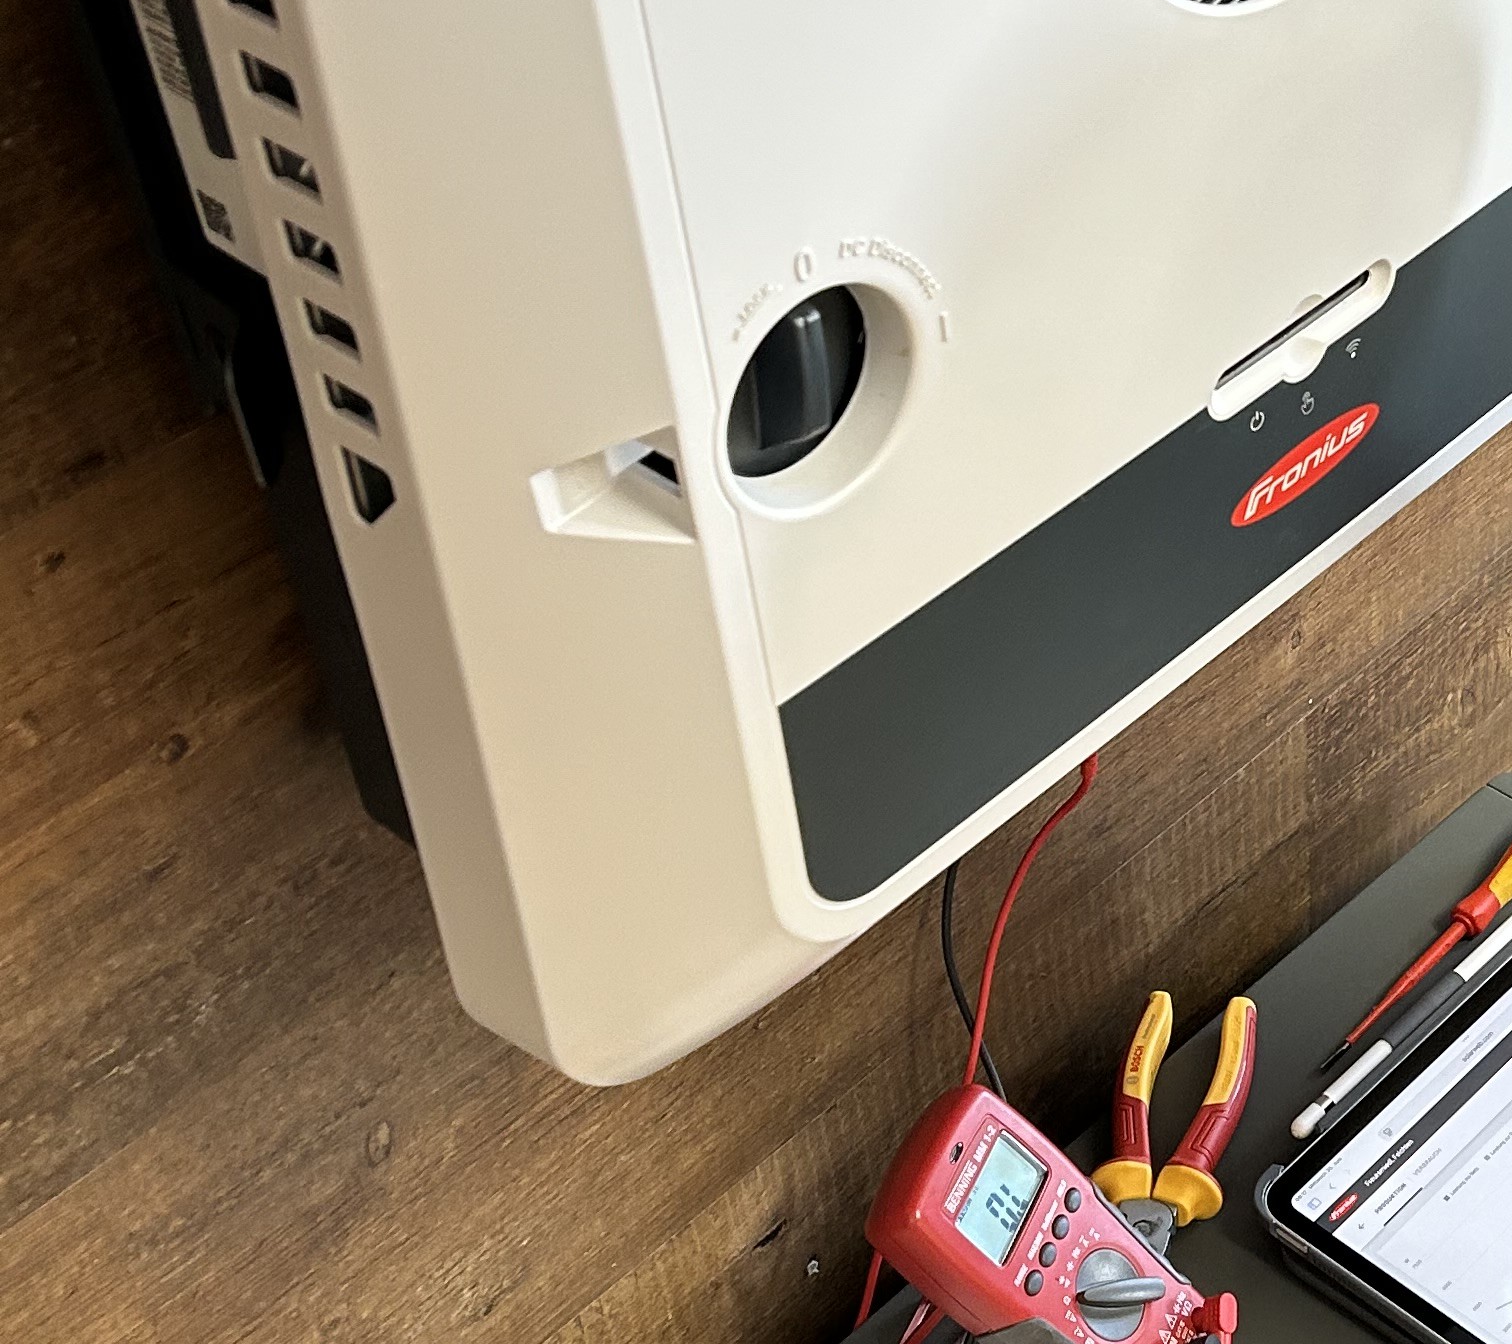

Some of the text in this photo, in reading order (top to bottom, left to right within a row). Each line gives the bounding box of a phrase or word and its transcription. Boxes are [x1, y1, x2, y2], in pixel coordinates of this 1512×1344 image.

[1243, 411, 1369, 521] Fronius
[1129, 1045, 1144, 1073] BOSCH
[944, 1159, 979, 1214] BENNING
